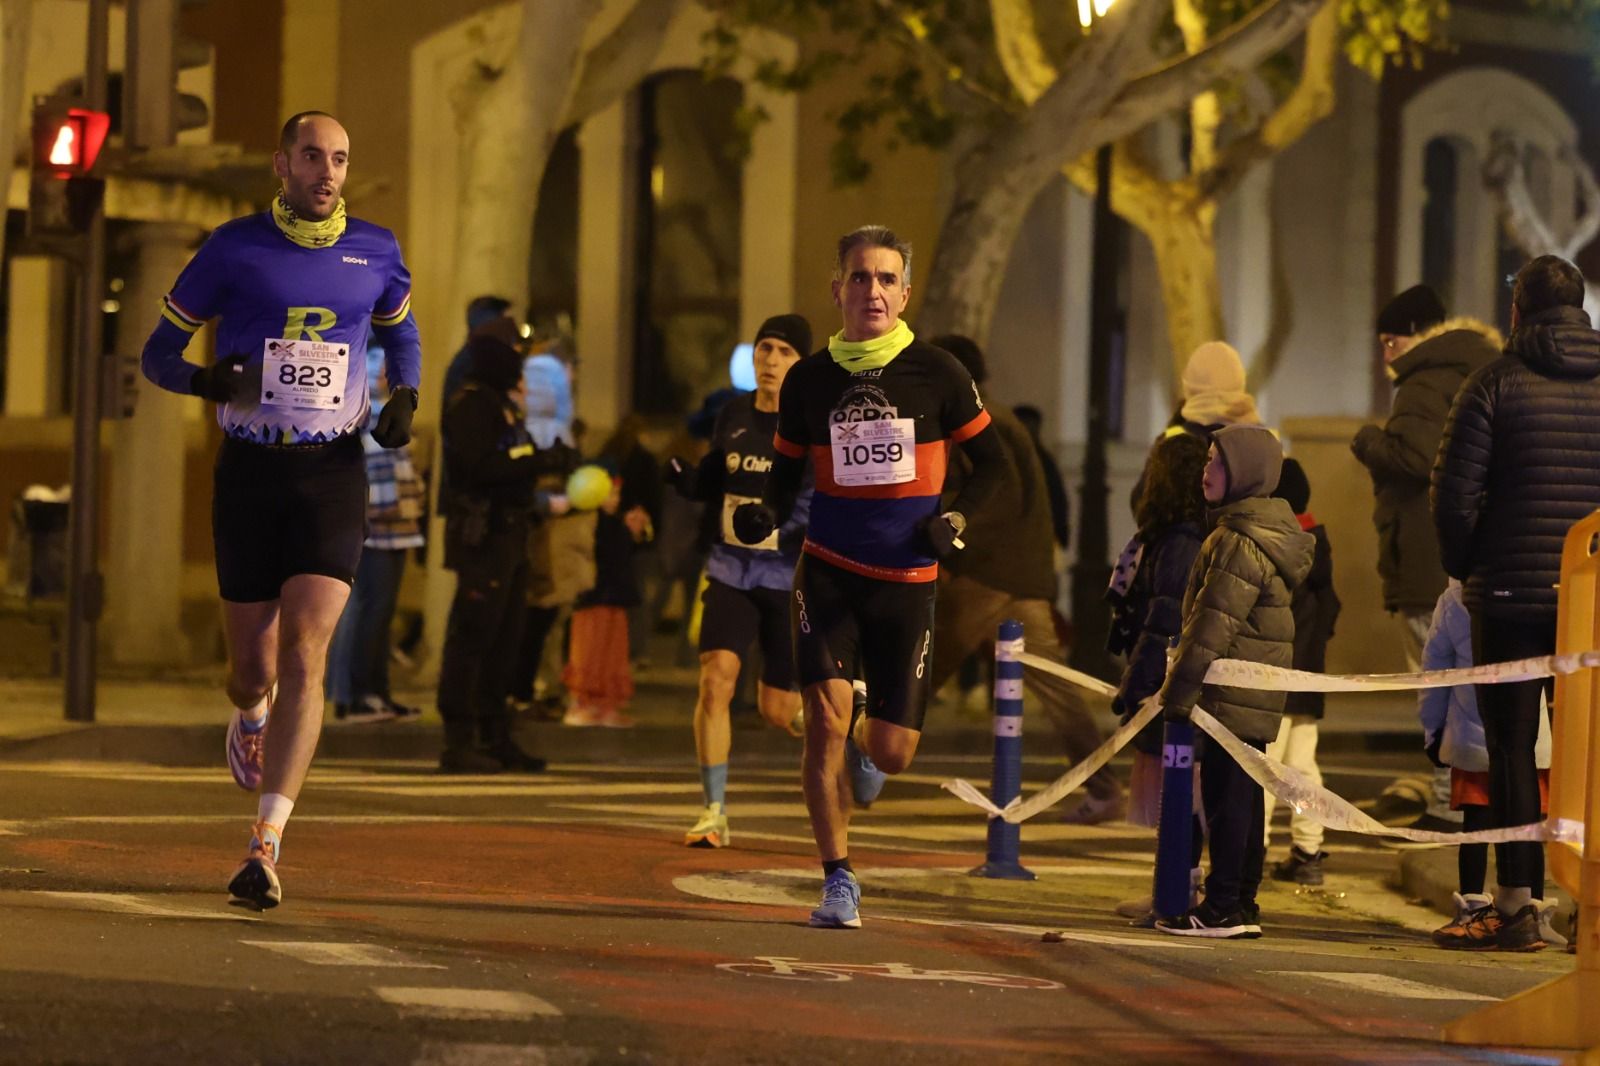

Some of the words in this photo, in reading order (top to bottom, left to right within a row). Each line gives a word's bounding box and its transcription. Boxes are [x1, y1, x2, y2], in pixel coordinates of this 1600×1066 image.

[283, 307, 336, 342] R
[311, 343, 330, 352] SAN
[299, 350, 339, 359] SILVESTRE
[279, 364, 331, 387] 823
[874, 421, 892, 430] SAN
[863, 428, 904, 436] SILVESTRE
[843, 443, 903, 466] 1059
